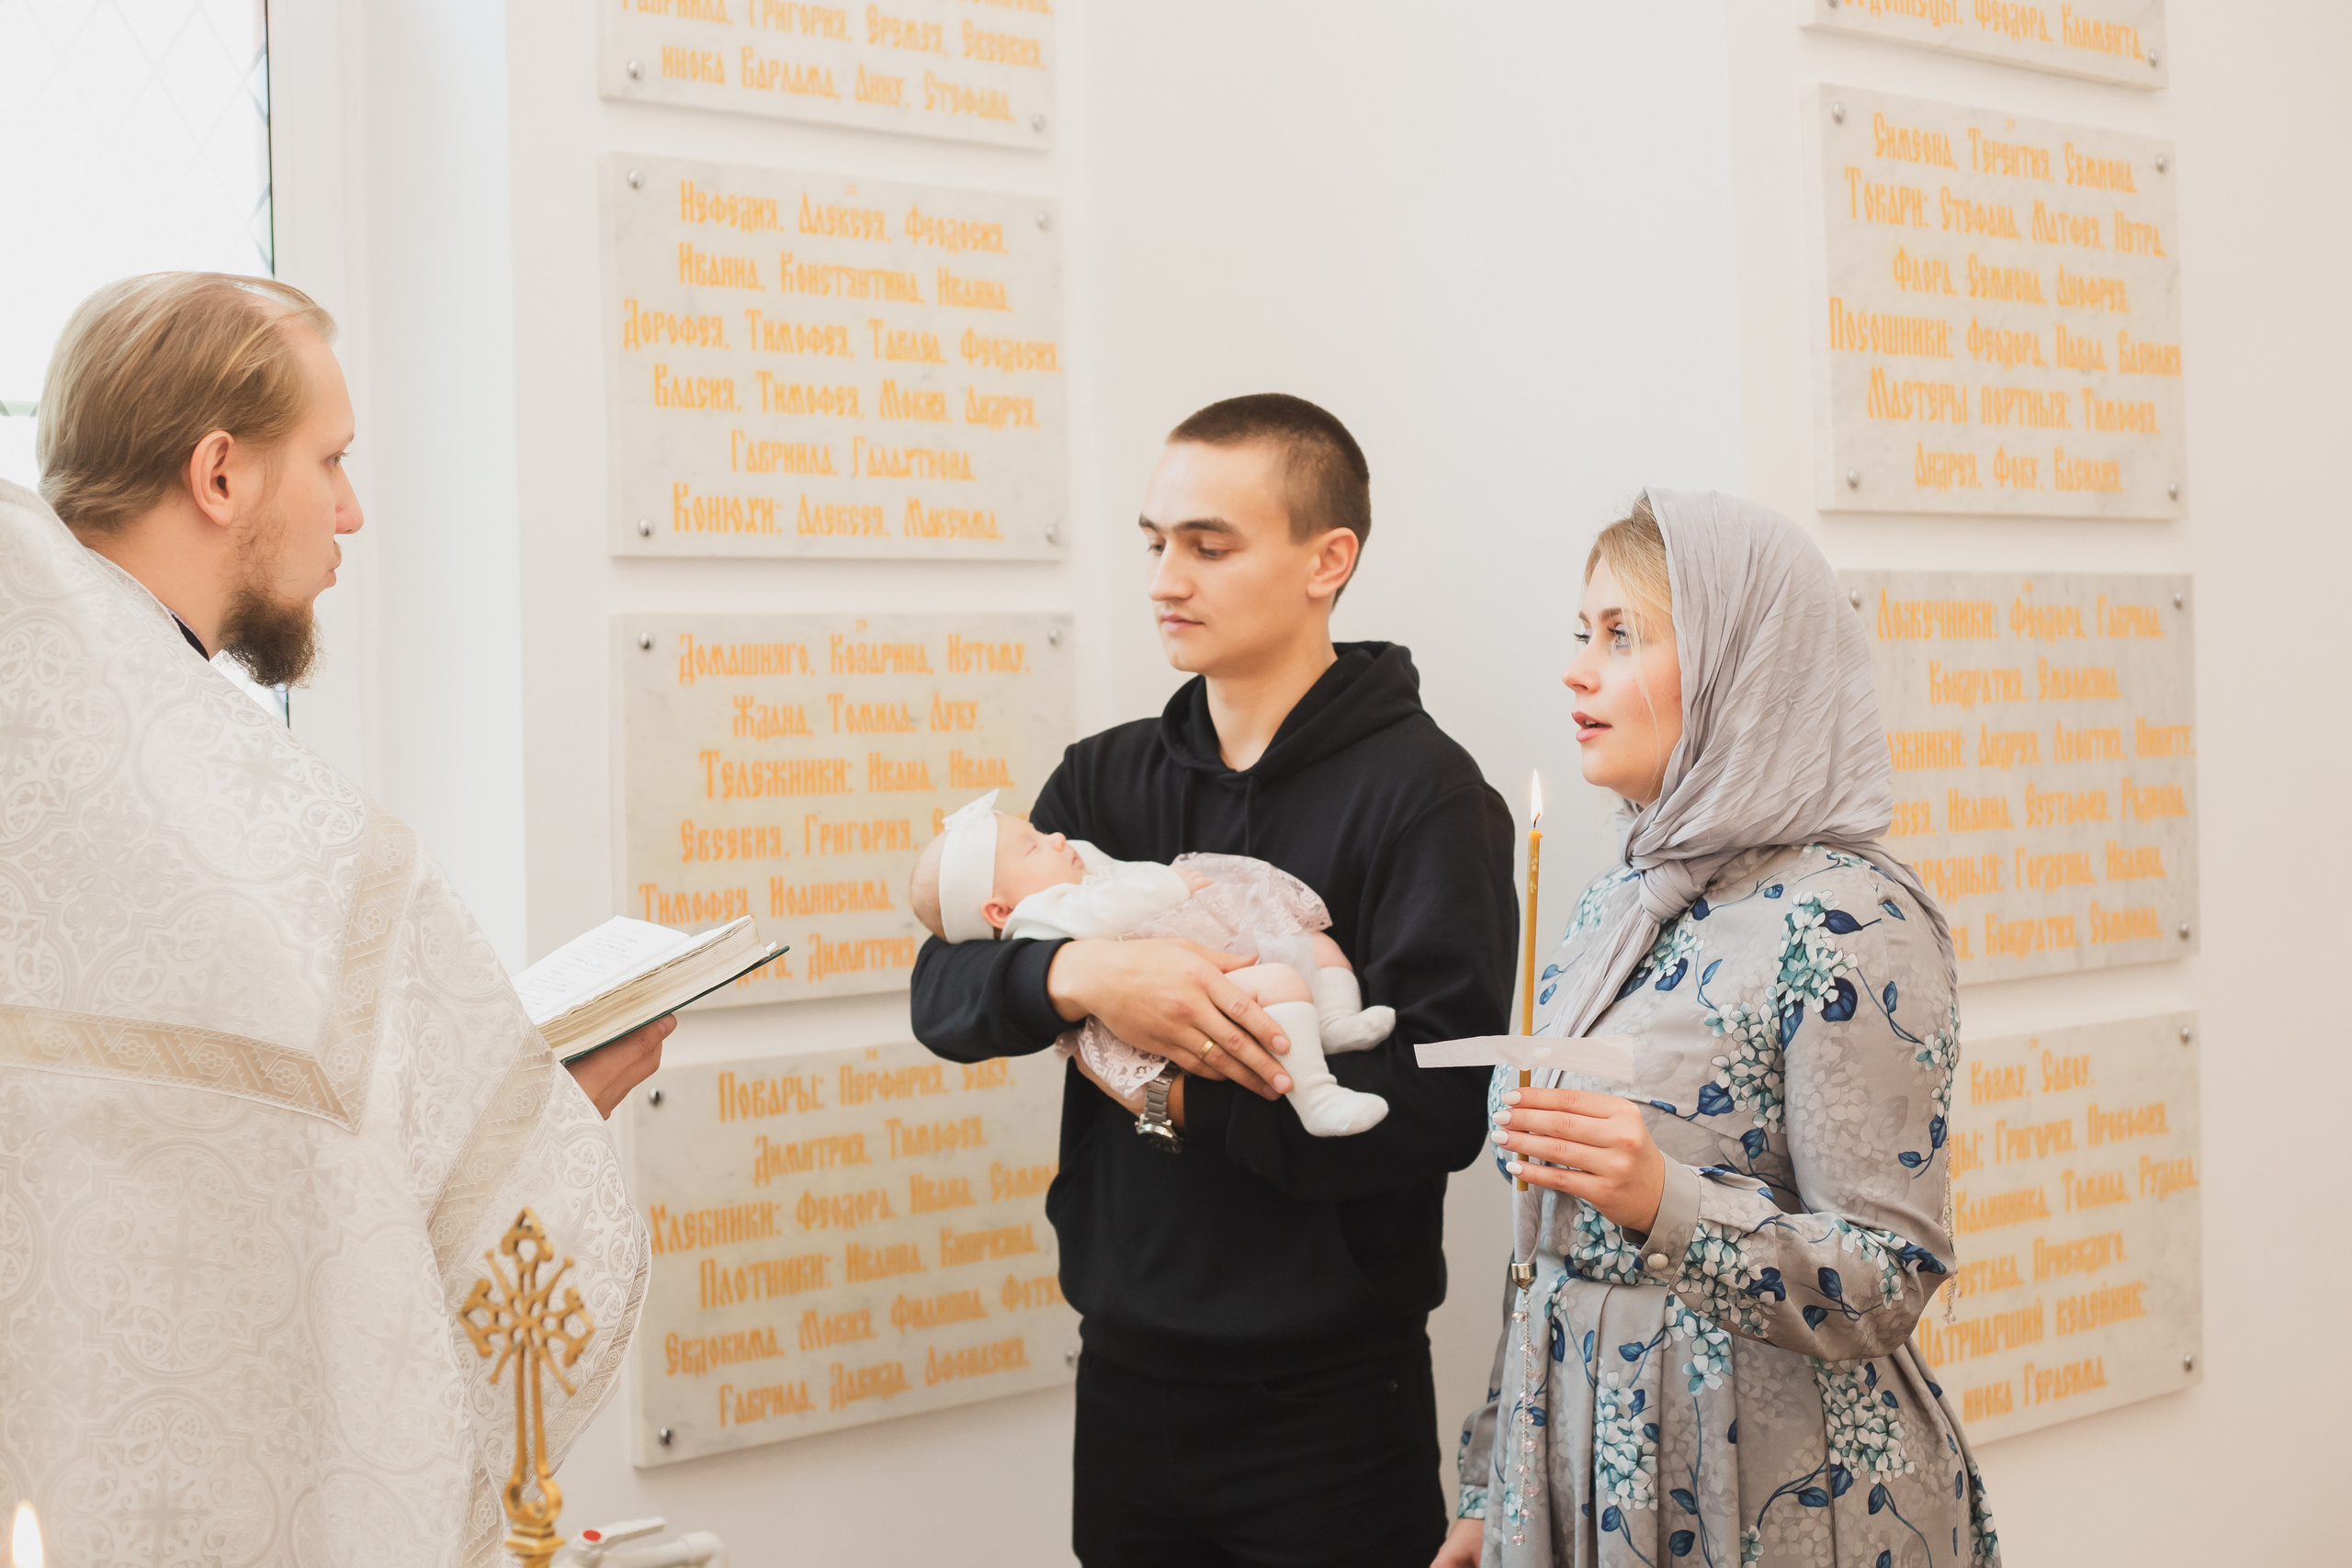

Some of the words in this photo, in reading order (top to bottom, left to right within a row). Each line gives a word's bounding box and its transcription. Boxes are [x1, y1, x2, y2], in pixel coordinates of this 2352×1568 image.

[1846, 168, 1927, 226] Токари:
[1831, 298, 1952, 357] Посошники:
[1879, 590, 1996, 639] Ложечники:
[701, 751, 852, 798] Тележники:
[719, 1073, 822, 1120] Повары:
[701, 1256, 829, 1308] Плотники:
